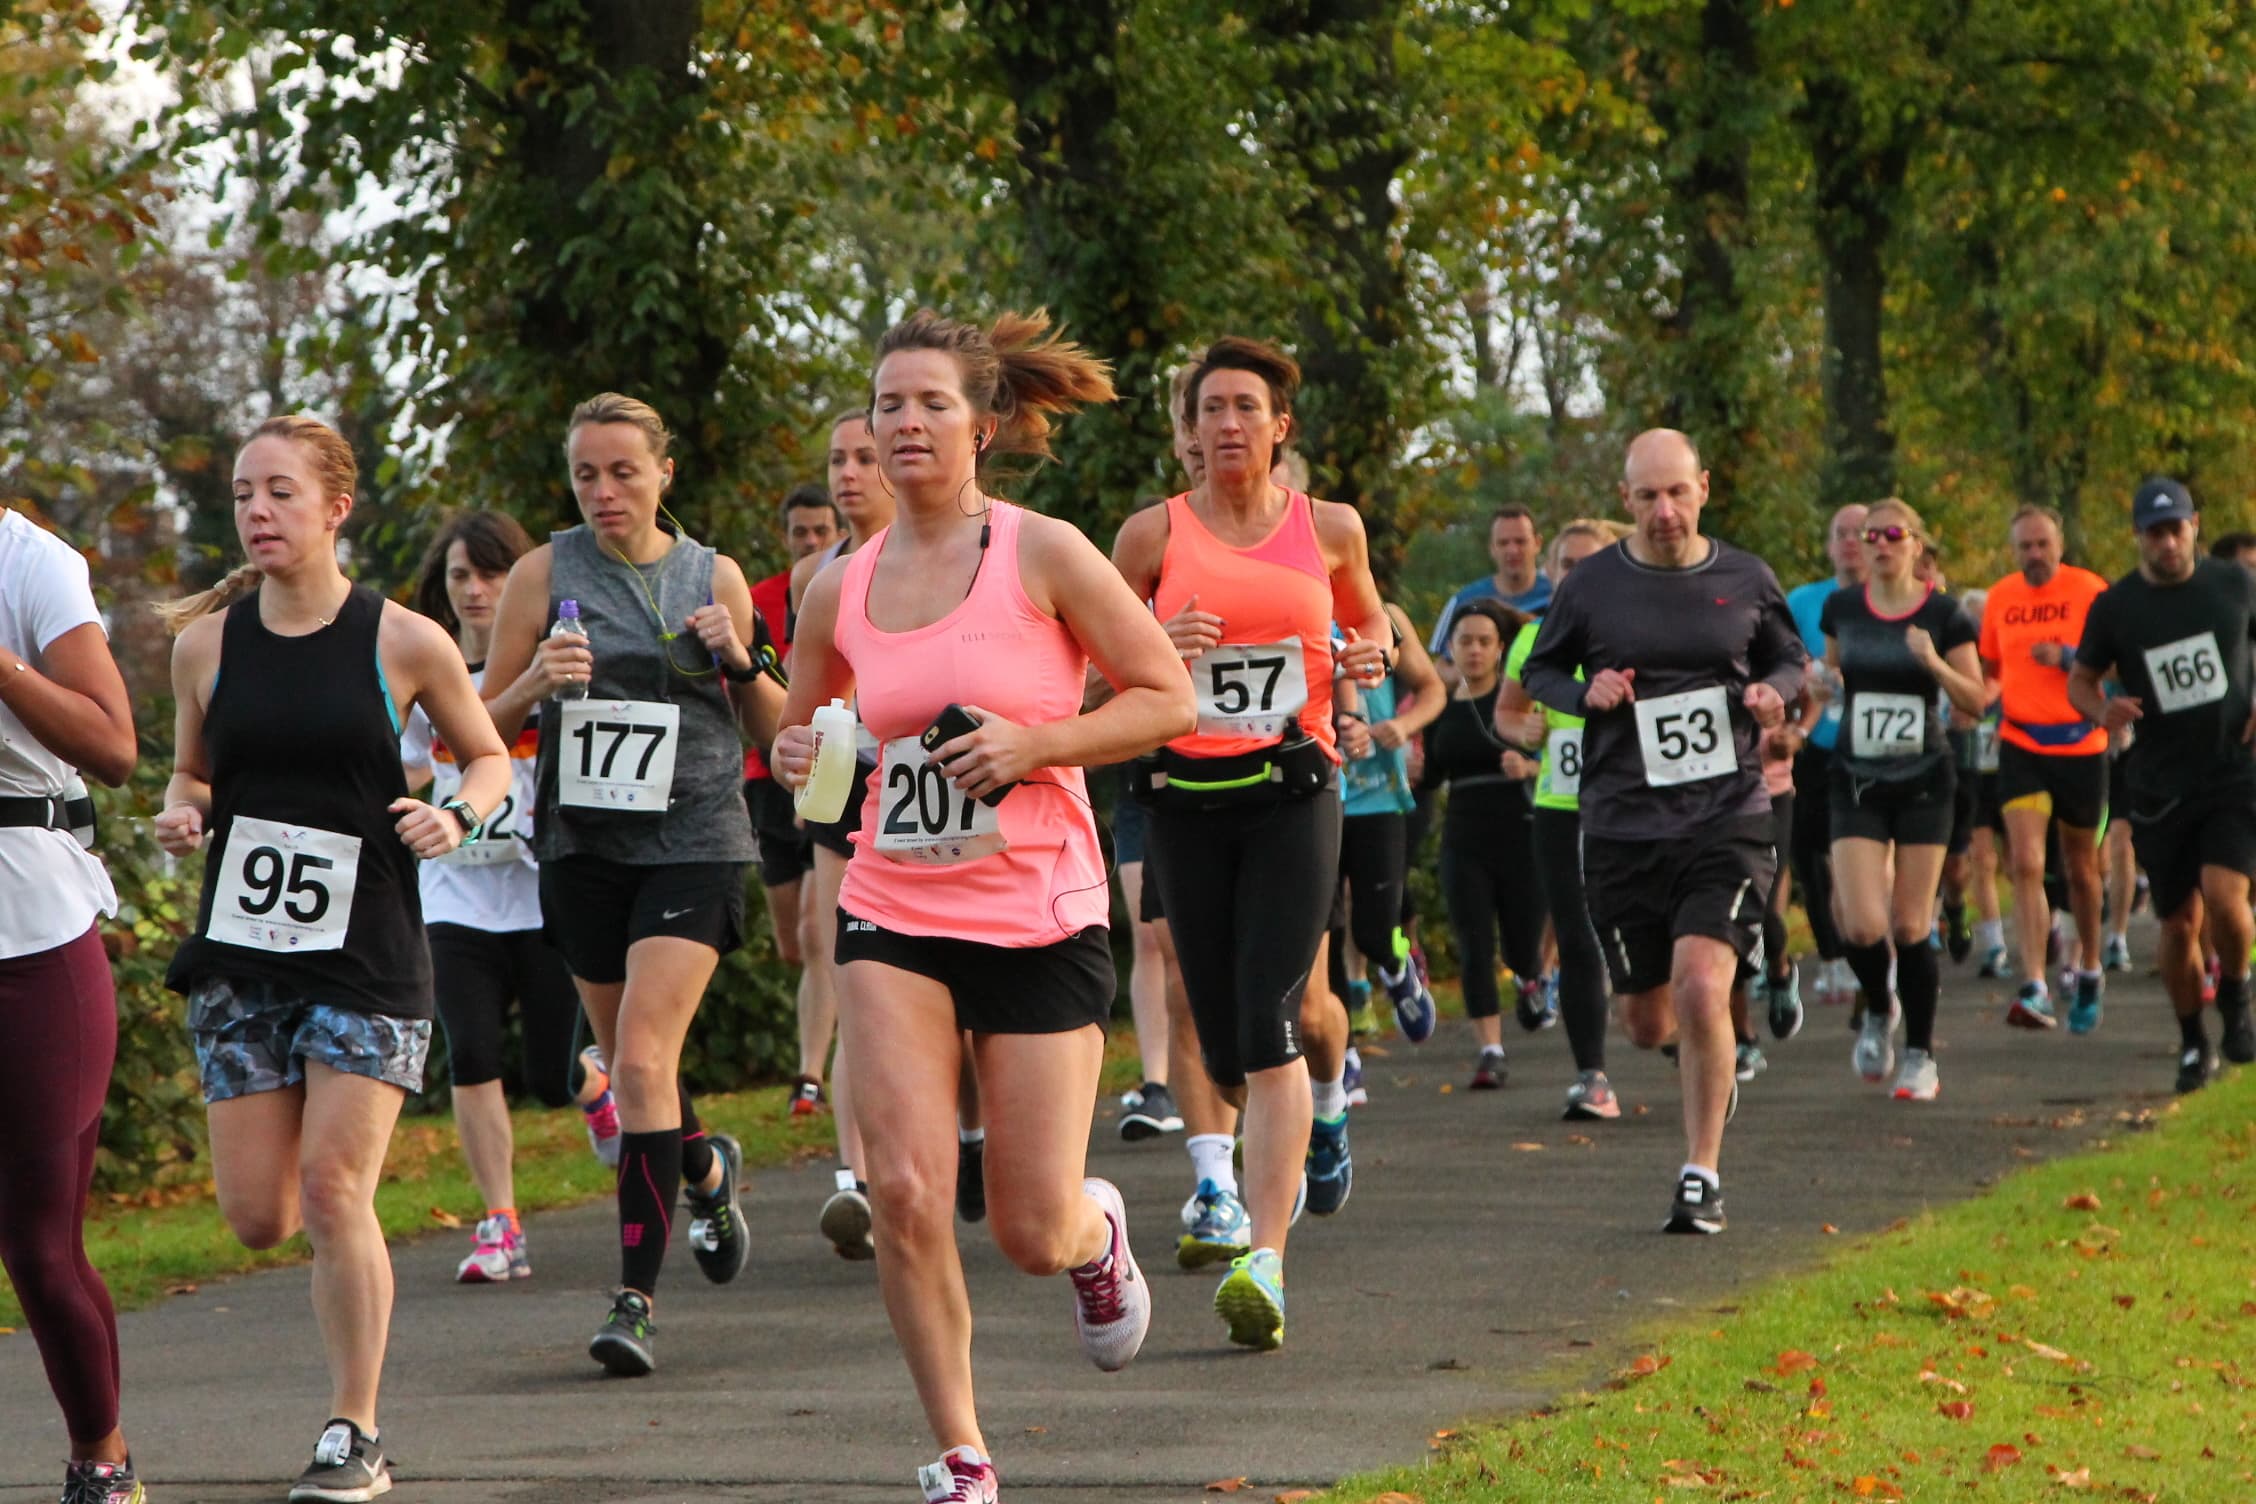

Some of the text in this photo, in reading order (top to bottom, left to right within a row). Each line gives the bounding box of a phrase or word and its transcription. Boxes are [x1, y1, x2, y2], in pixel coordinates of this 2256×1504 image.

[2005, 602, 2069, 625] GUIDE
[1211, 655, 1286, 714] 57
[2158, 649, 2216, 693] 166
[1656, 708, 1719, 760] 53
[1862, 707, 1917, 740] 172
[573, 721, 667, 780] 177
[238, 846, 334, 924] 95
